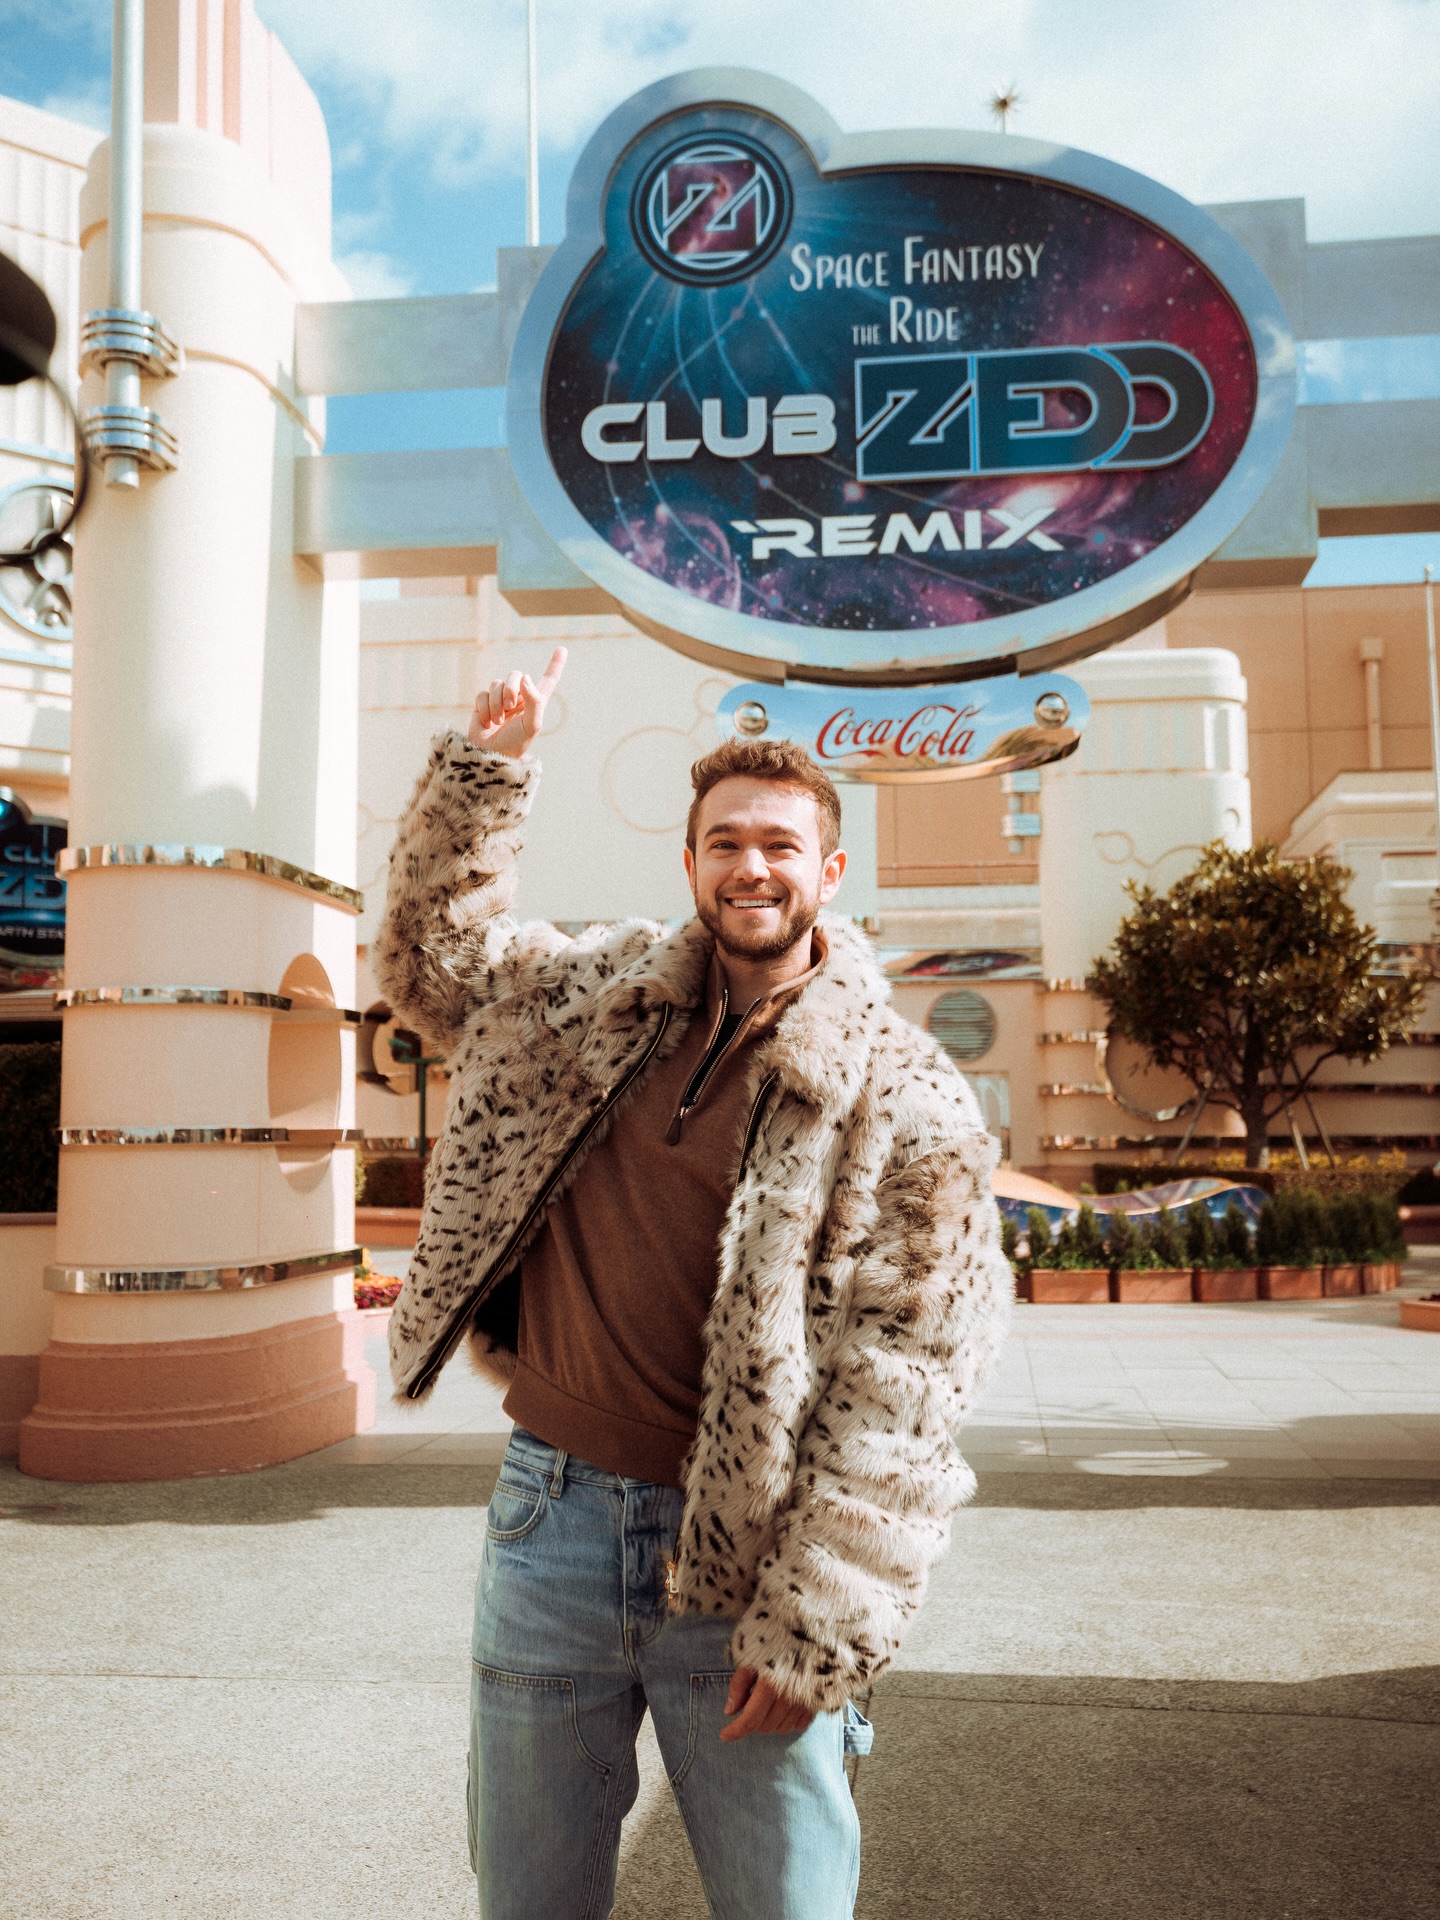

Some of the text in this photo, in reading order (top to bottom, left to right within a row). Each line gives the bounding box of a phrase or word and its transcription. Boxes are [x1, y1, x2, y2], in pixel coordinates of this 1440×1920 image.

[580, 340, 1215, 484] CLUB ZEDD
[730, 505, 1065, 562] REMIX
[815, 704, 983, 760] Coca-Cola
[4, 845, 56, 865] CLU
